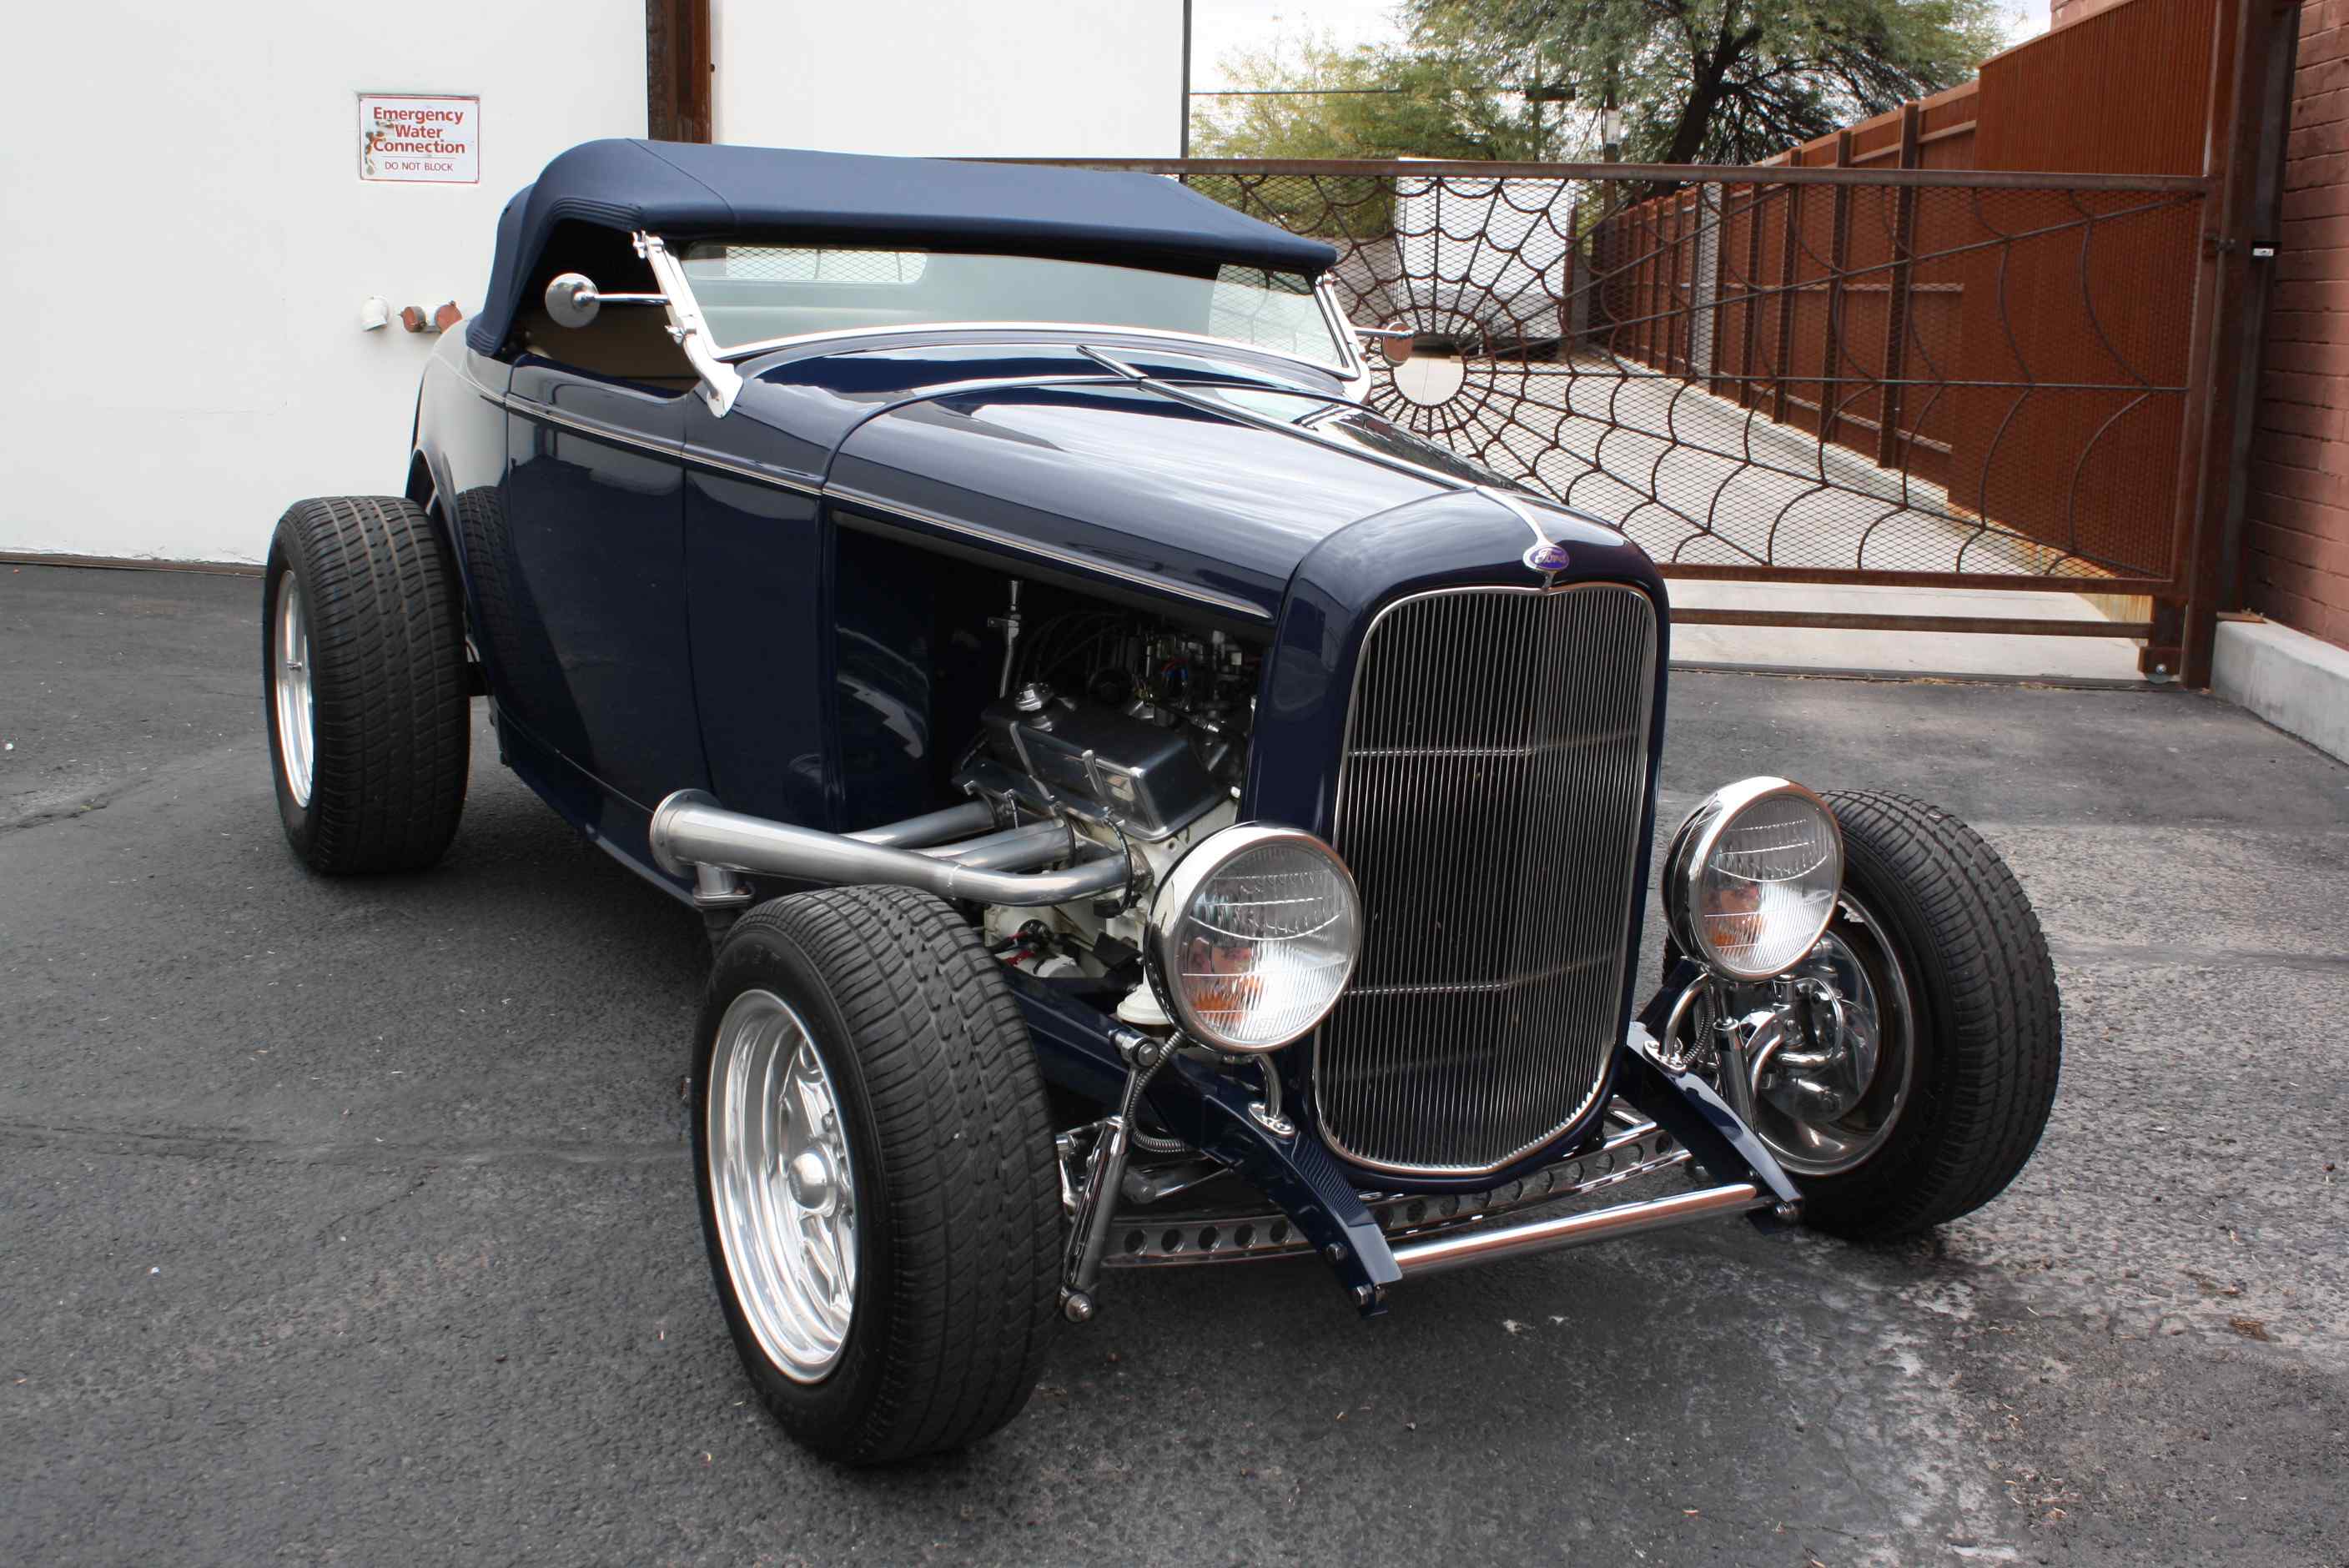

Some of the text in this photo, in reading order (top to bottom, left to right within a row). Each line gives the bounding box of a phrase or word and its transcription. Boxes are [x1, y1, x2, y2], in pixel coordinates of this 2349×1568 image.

[374, 106, 464, 124] Emergency
[394, 124, 444, 138] Water
[373, 139, 465, 153] Connection
[385, 161, 454, 172] DO NOT BLOCK
